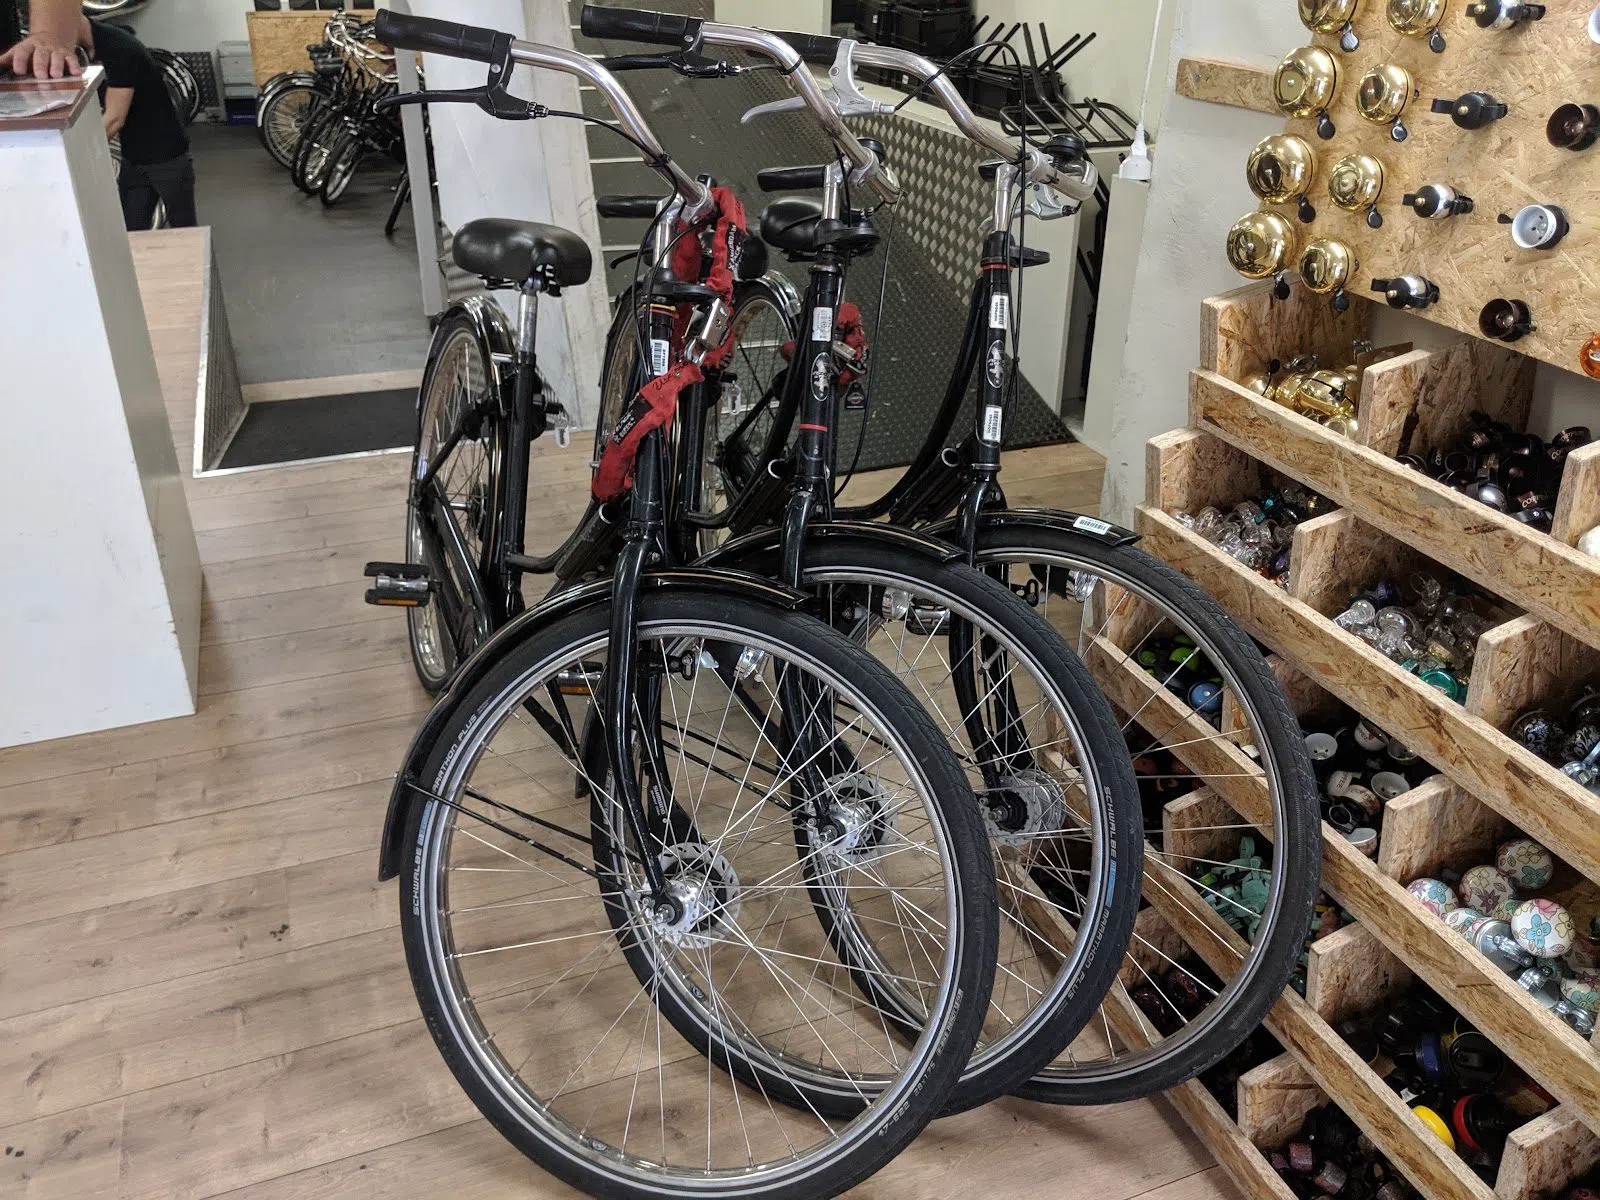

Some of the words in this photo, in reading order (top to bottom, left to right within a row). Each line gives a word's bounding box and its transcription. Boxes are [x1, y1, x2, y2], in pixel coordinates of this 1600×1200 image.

[431, 743, 458, 796] ARATHON
[458, 713, 477, 740] PLUS
[1105, 786, 1117, 858] SCHWALBE
[413, 847, 423, 916] SCHWALBE
[1084, 908, 1110, 971] MARATHON
[1066, 970, 1085, 1000] PLUS
